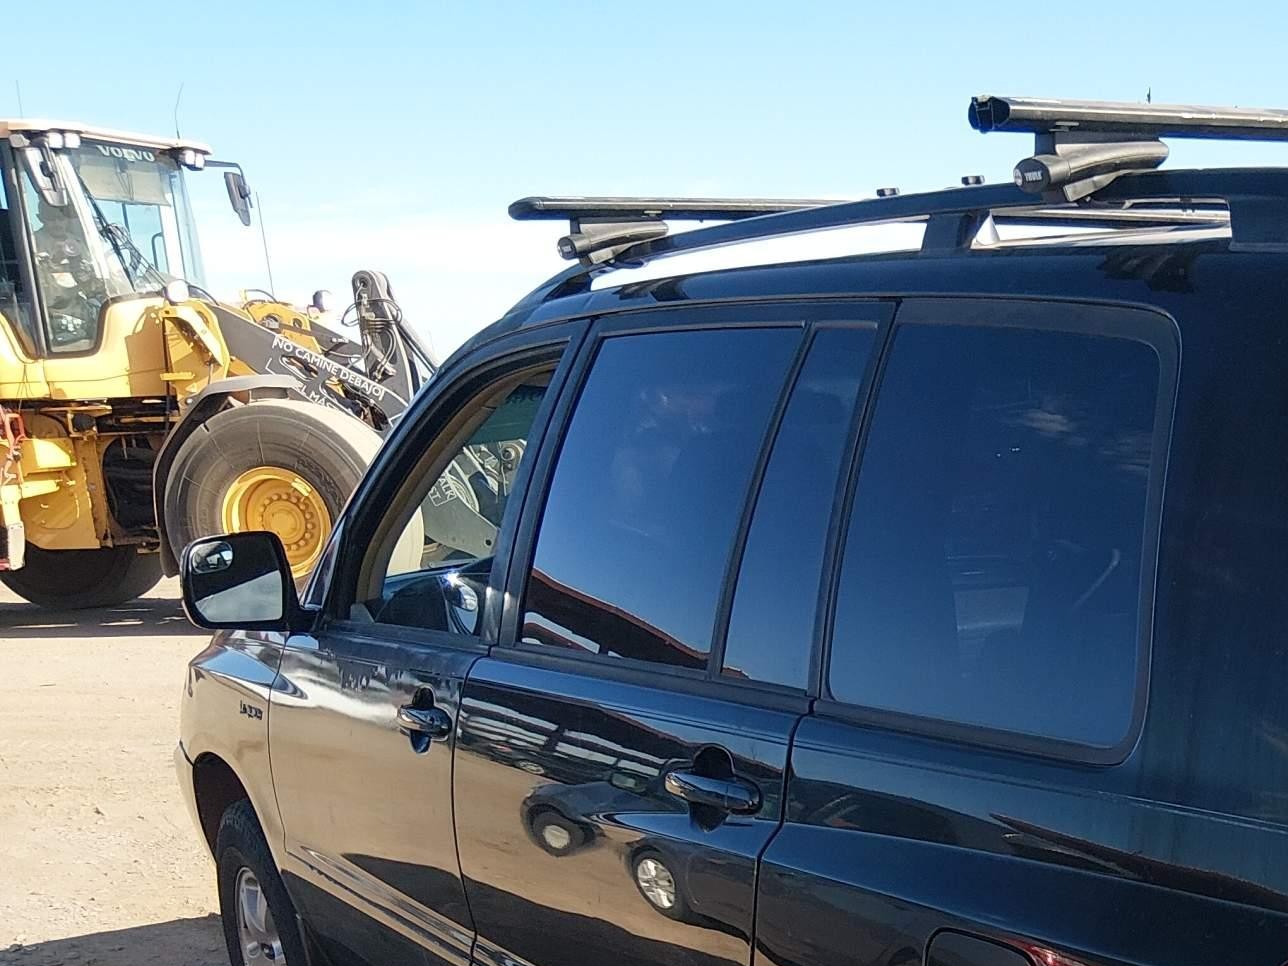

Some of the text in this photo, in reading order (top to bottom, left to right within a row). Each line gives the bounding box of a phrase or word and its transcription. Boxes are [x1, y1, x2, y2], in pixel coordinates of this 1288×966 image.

[96, 145, 155, 161] VOLVO
[272, 337, 382, 397] NO CAMINE DEBAJO
